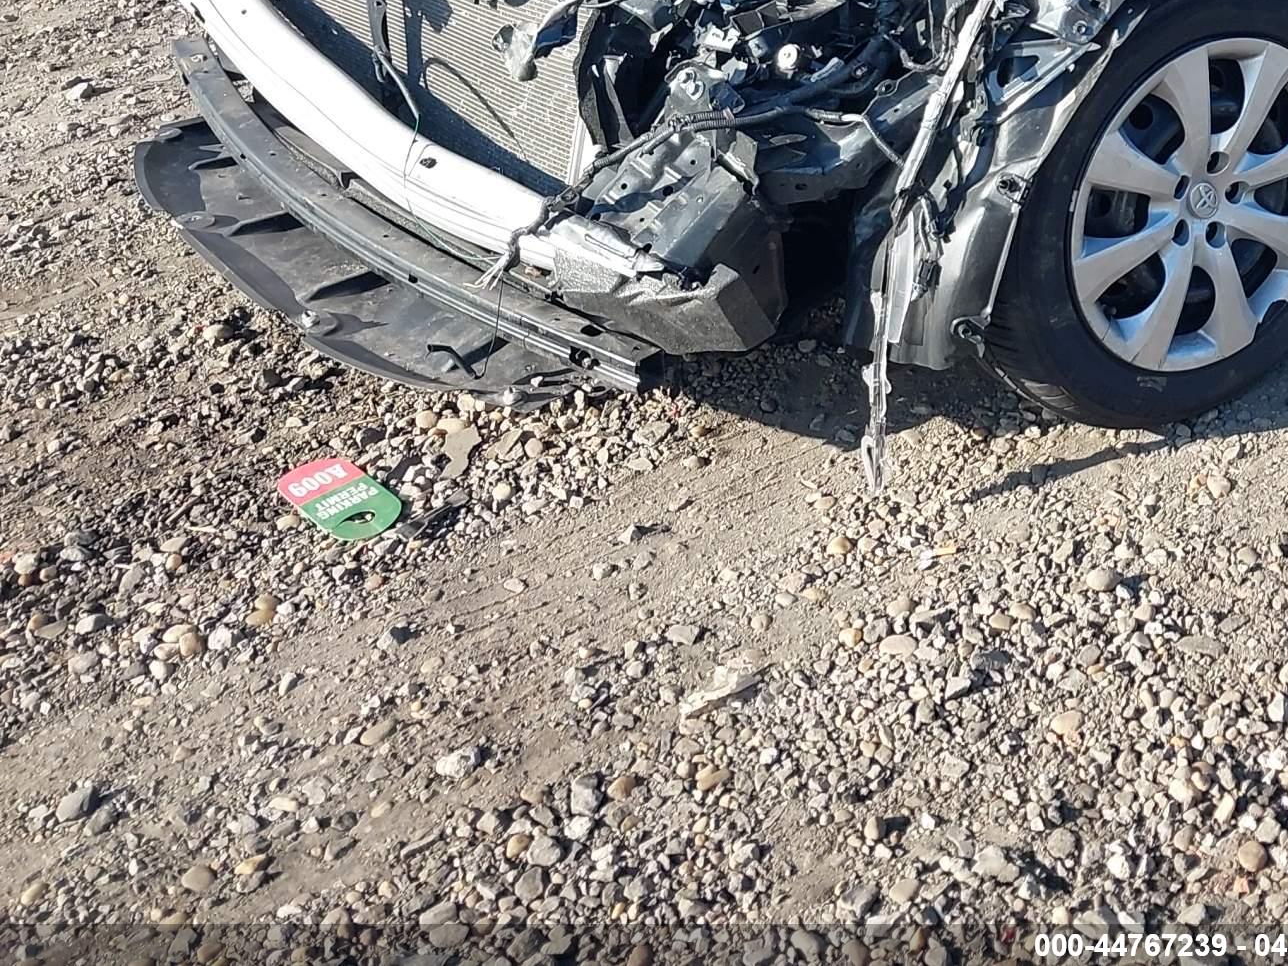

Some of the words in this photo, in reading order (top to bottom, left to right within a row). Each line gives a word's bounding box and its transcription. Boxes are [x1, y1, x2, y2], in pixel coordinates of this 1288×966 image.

[288, 464, 348, 497] A009
[314, 482, 369, 511] PERMIT
[316, 487, 379, 520] PARKING
